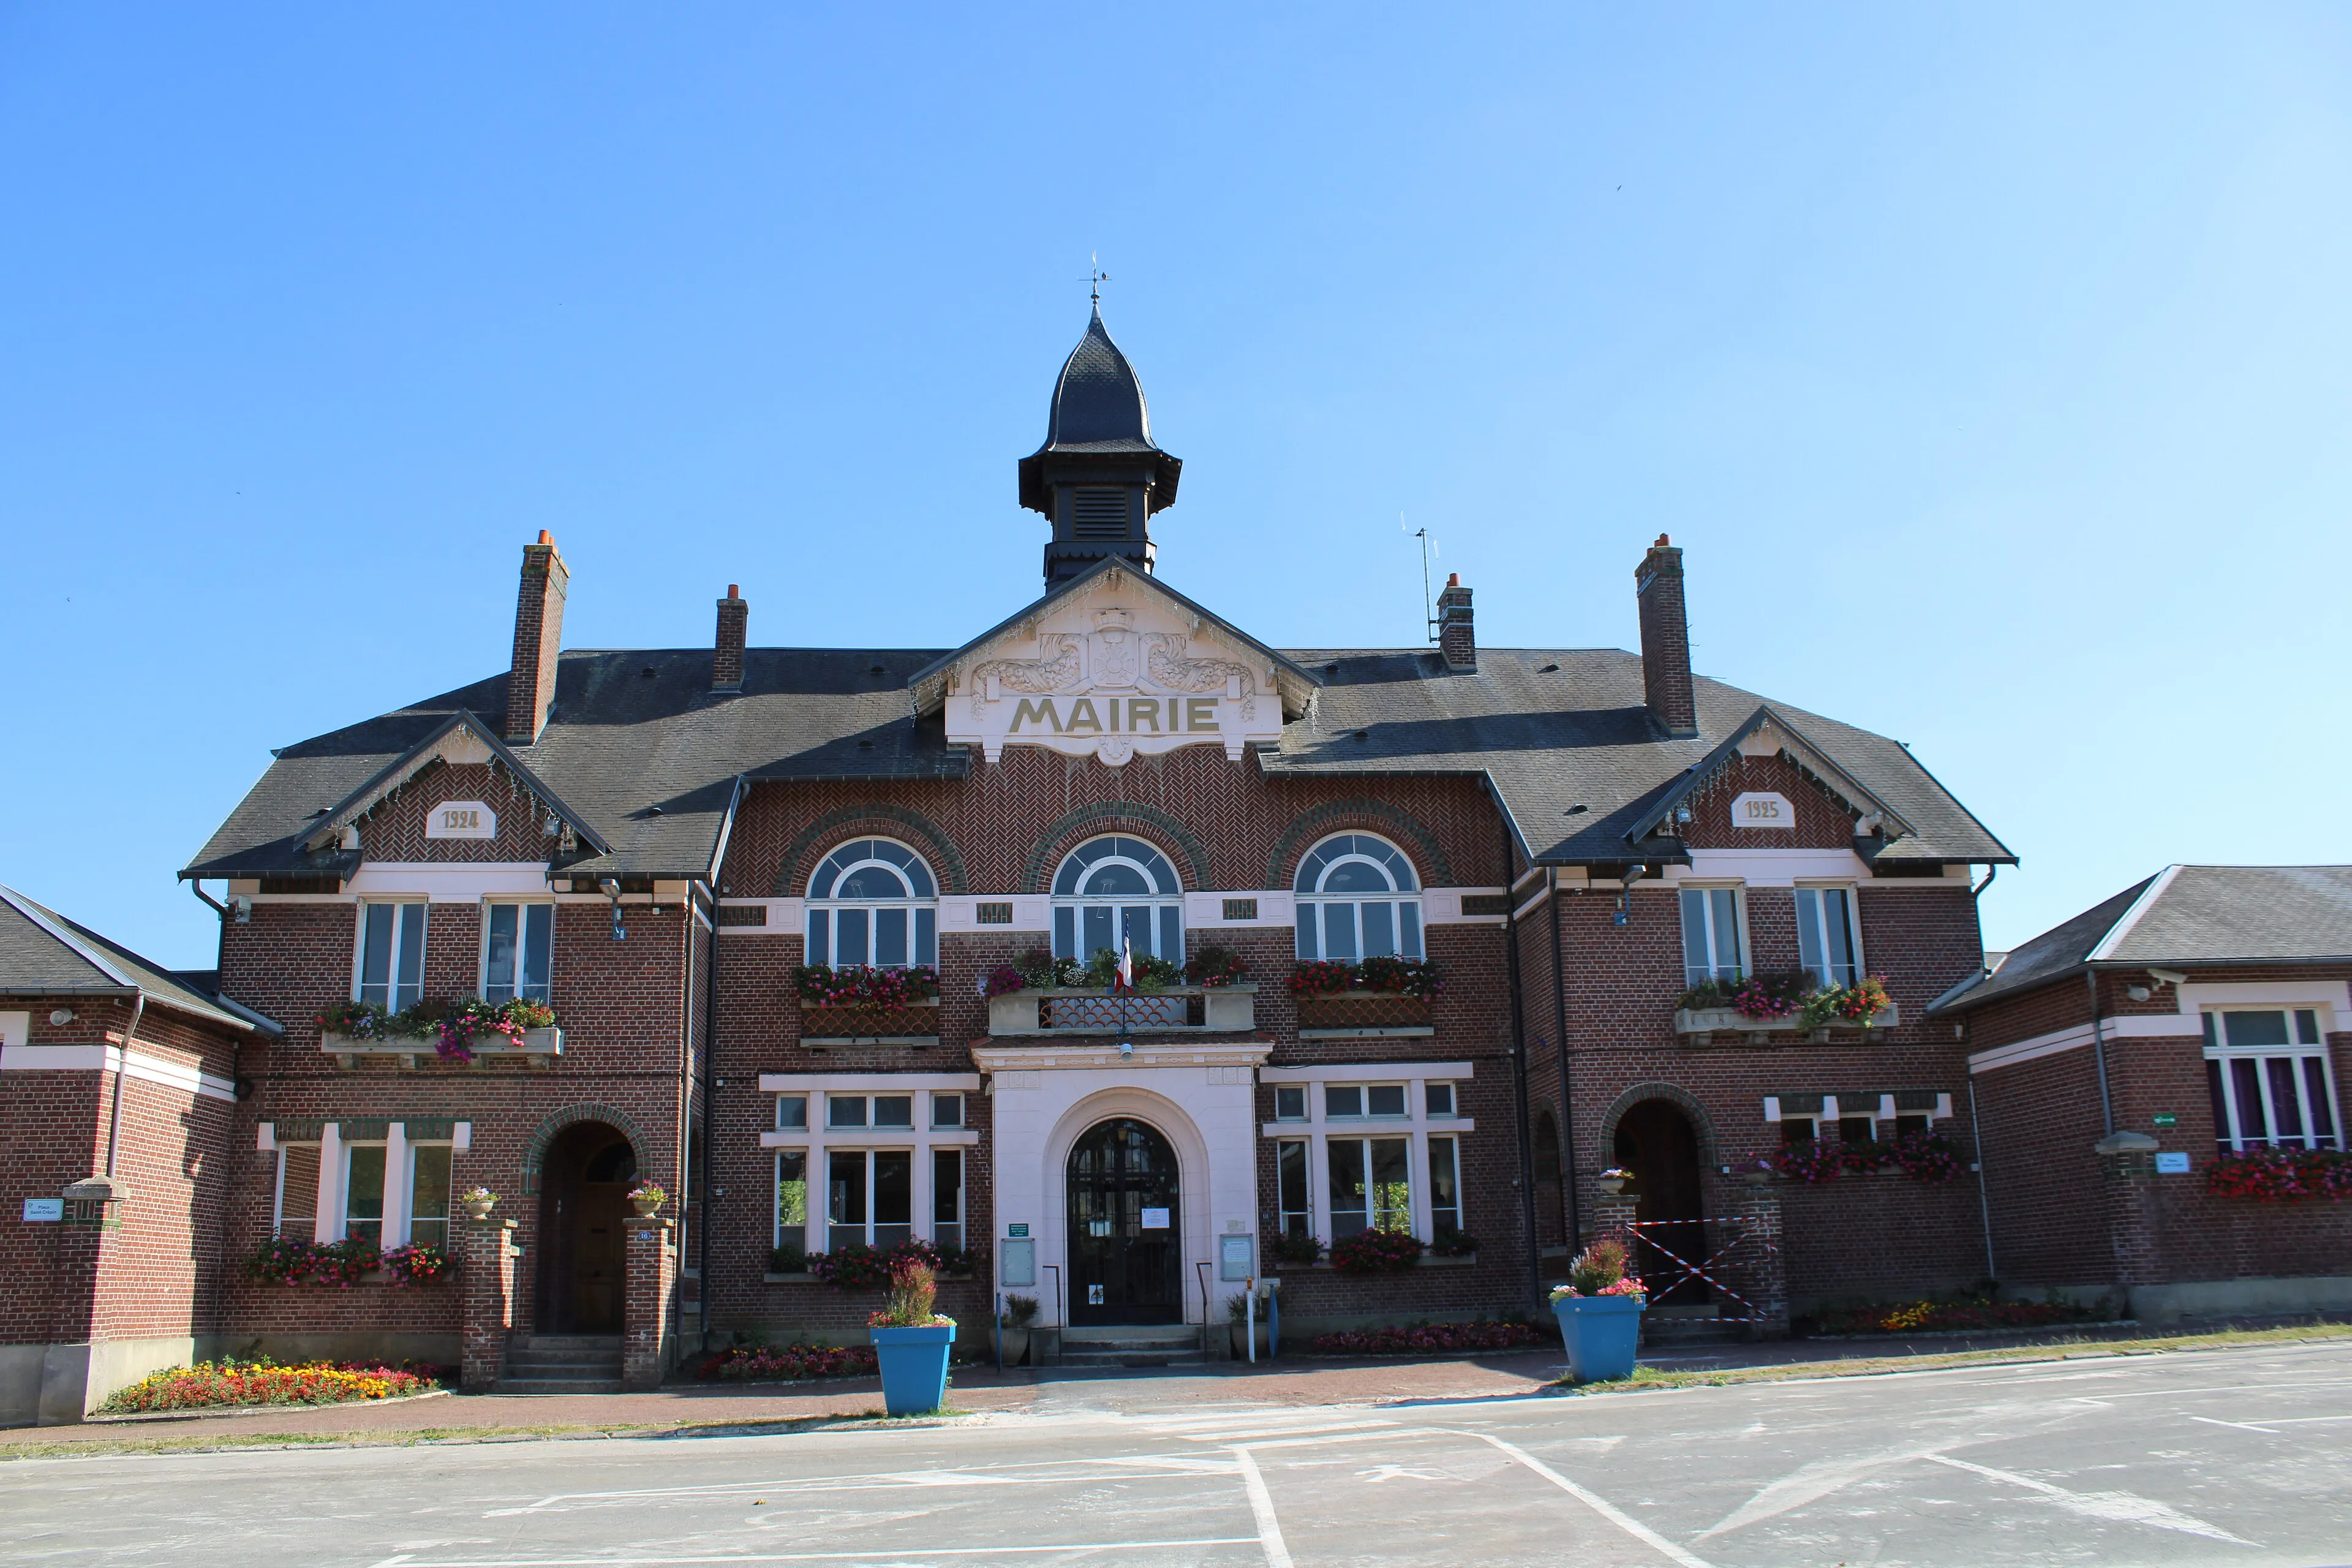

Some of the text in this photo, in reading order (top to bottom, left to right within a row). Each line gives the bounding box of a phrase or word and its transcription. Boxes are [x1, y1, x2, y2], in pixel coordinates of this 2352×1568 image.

[1009, 698, 1219, 733] MAIRIE
[1744, 801, 1779, 818] 1925
[441, 810, 480, 829] 1924
